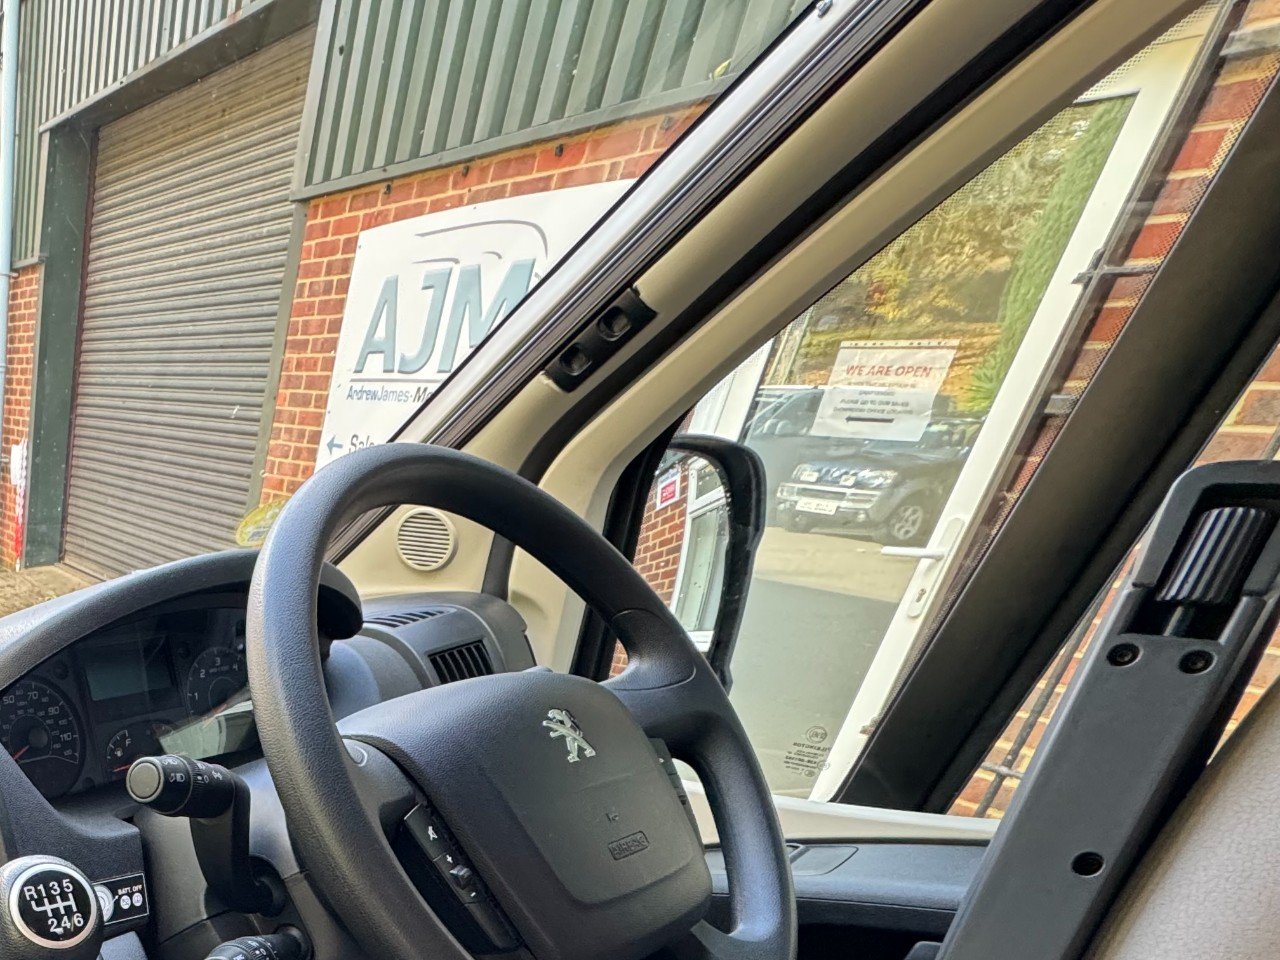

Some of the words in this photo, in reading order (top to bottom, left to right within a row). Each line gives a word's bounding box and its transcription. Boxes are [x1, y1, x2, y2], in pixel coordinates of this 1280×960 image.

[353, 258, 536, 374] AJM
[846, 364, 866, 376] WE
[867, 365, 894, 377] ARE
[895, 366, 933, 378] OPEN
[2, 695, 15, 704] 50
[27, 691, 38, 700] 70
[48, 706, 60, 715] 90
